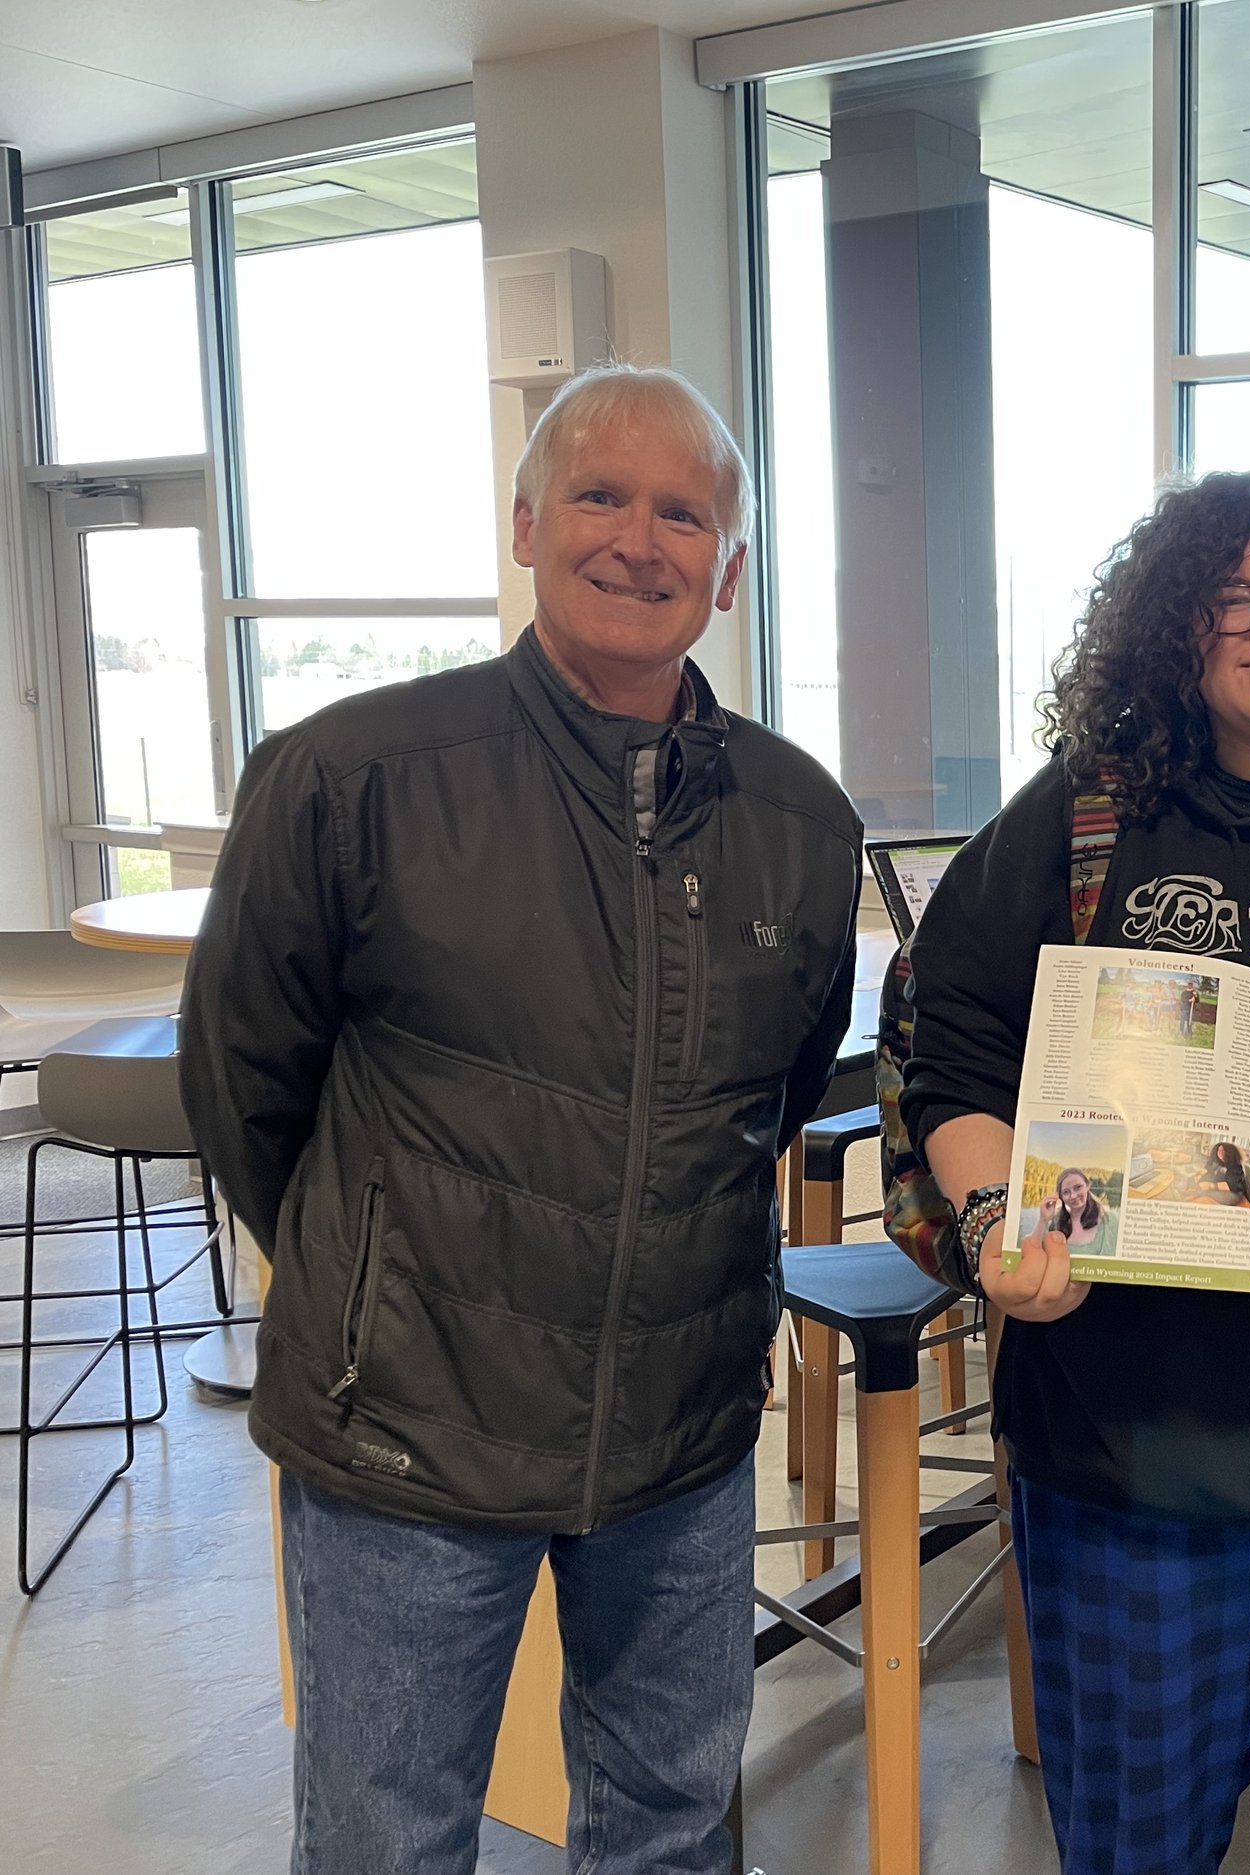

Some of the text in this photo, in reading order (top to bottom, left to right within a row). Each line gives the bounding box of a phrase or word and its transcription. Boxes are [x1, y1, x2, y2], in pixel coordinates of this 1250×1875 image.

[1129, 957, 1193, 971] Volunteers!
[1061, 1109, 1085, 1119] 2023
[1192, 1119, 1230, 1131] Interns
[1070, 1266, 1086, 1274] ted
[1086, 1267, 1095, 1275] in
[1096, 1268, 1134, 1279] Wyoming
[1155, 1272, 1183, 1282] Impact
[1185, 1274, 1211, 1284] Report
